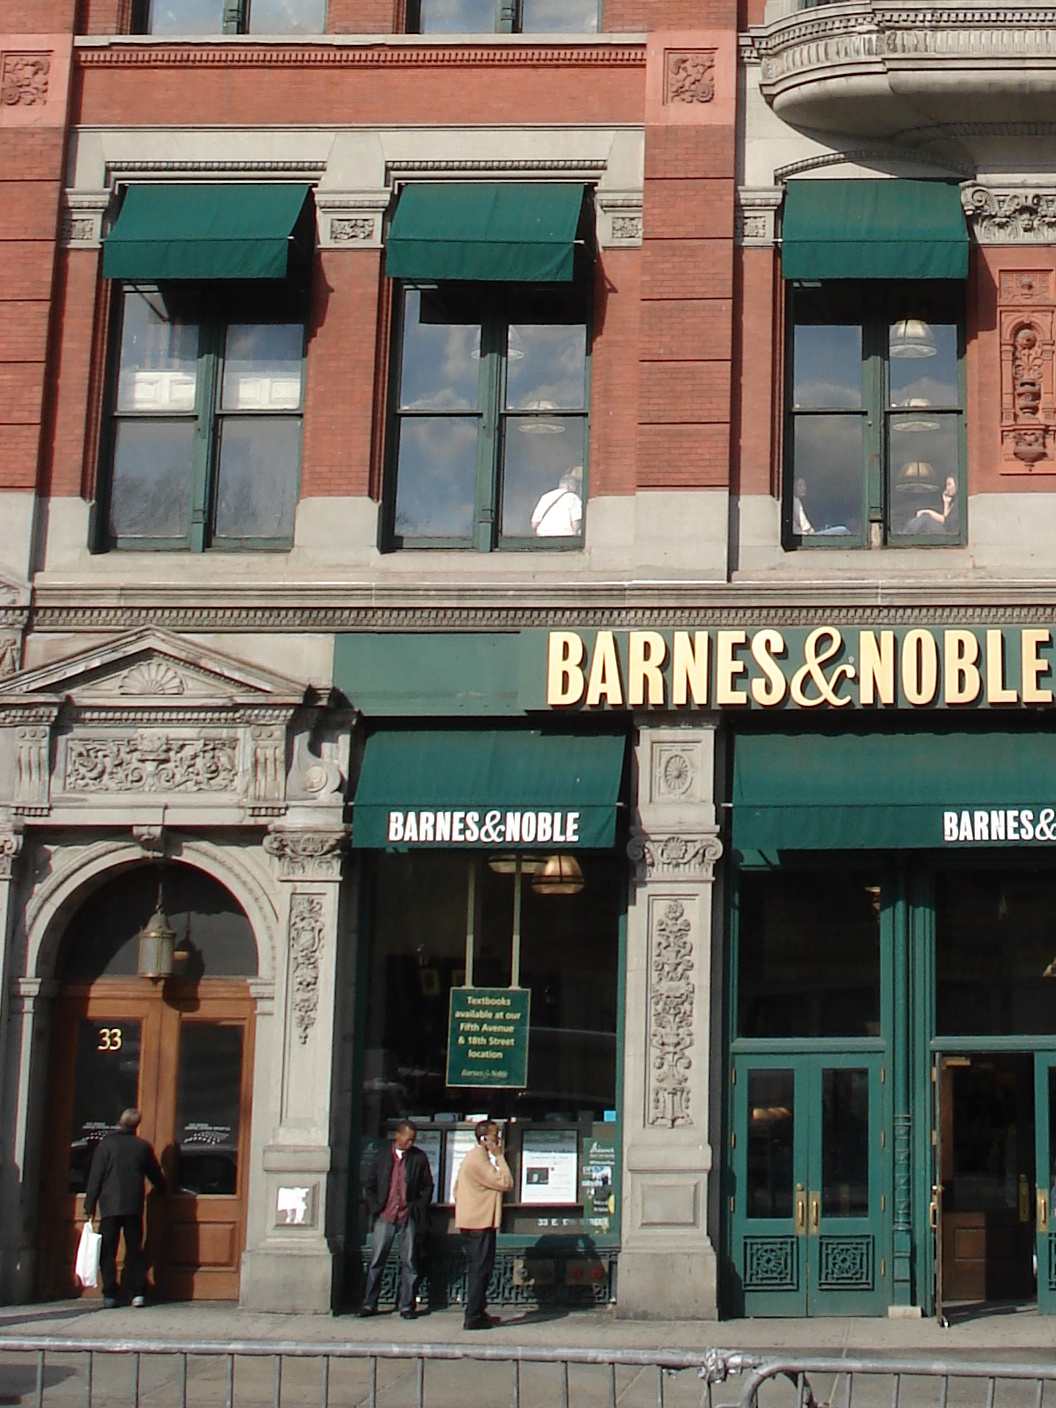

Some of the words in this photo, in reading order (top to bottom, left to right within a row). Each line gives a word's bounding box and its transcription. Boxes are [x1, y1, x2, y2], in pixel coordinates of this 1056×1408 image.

[546, 625, 1054, 707] BARNES&NOBLE
[388, 809, 580, 843] BARNES&NOBLE
[467, 996, 511, 1006] Textbooks
[454, 1010, 493, 1020] available
[494, 1011, 504, 1020] at
[505, 1012, 522, 1020] our
[459, 1022, 480, 1032] Fifth
[481, 1023, 515, 1033] Avenue
[97, 1028, 122, 1051] 33
[458, 1036, 465, 1045] &
[467, 1036, 487, 1046] 18th
[488, 1037, 515, 1046] Street
[467, 1049, 503, 1059] location
